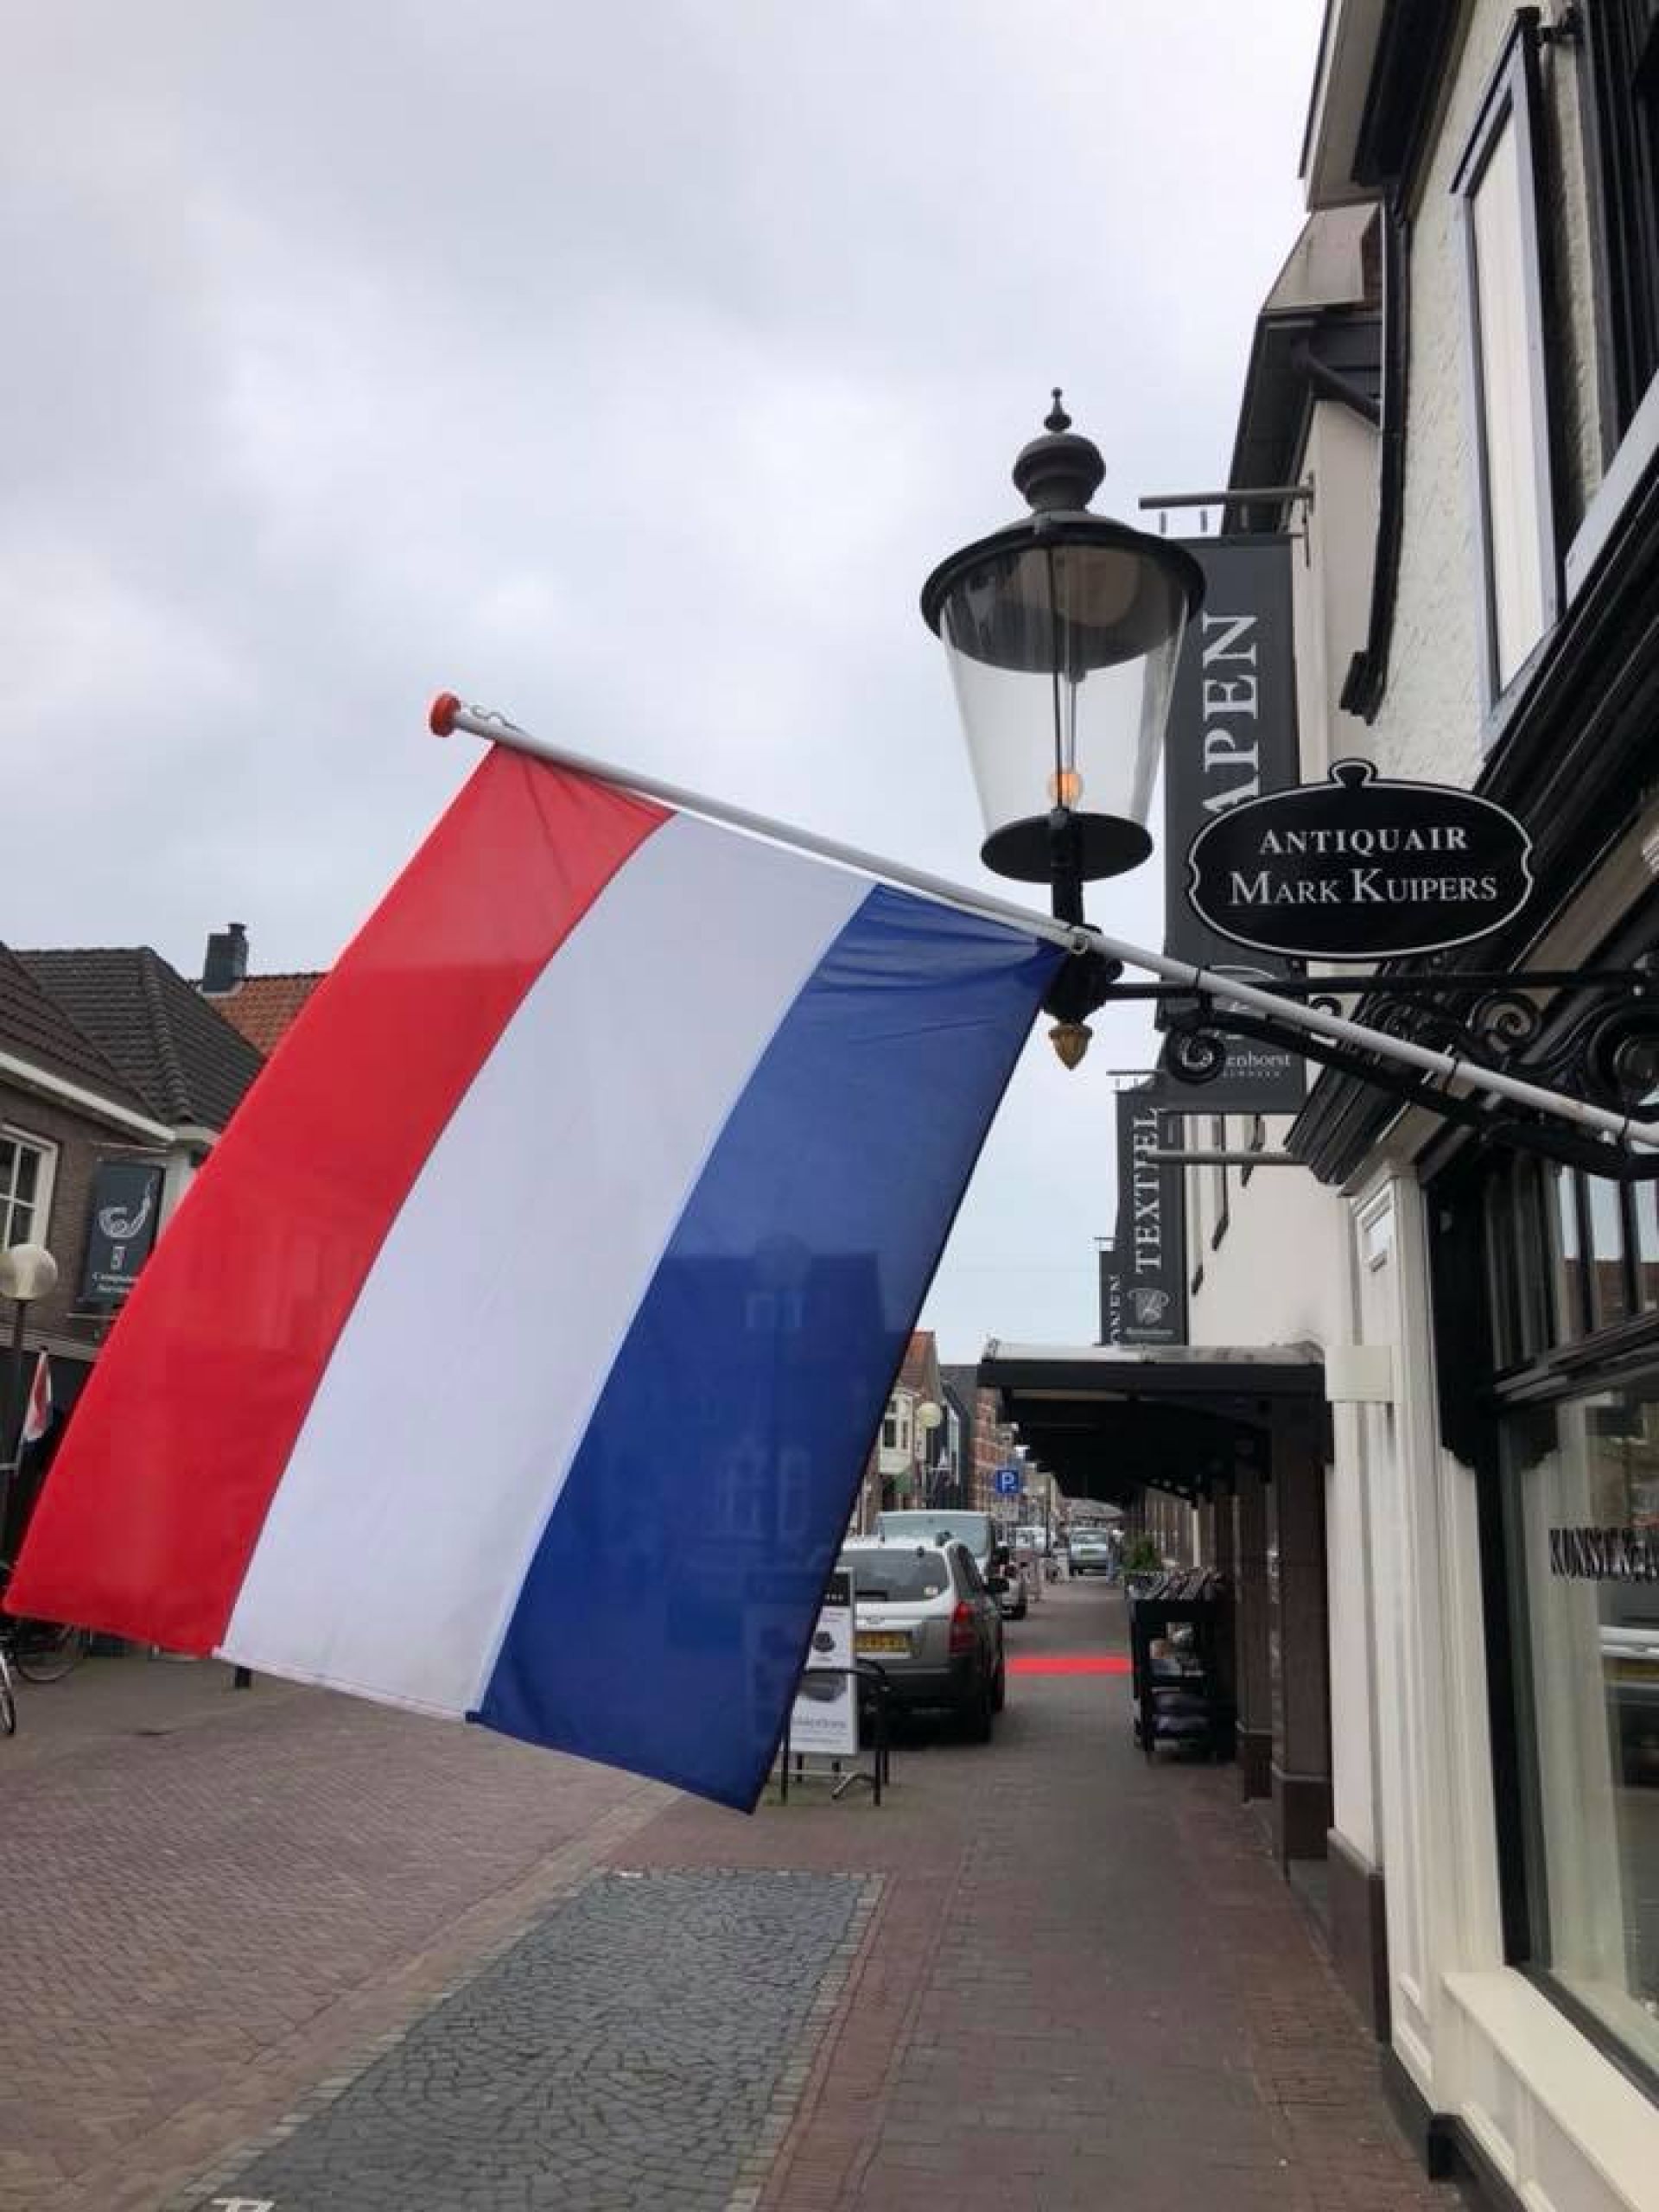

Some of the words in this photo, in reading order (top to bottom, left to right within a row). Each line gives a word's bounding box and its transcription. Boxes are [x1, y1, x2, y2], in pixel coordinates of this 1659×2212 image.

[1258, 826, 1468, 857] ANTIQUAIR
[1228, 869, 1341, 906] MARK
[1348, 868, 1497, 903] KUIPERS
[1001, 1471, 1015, 1493] P
